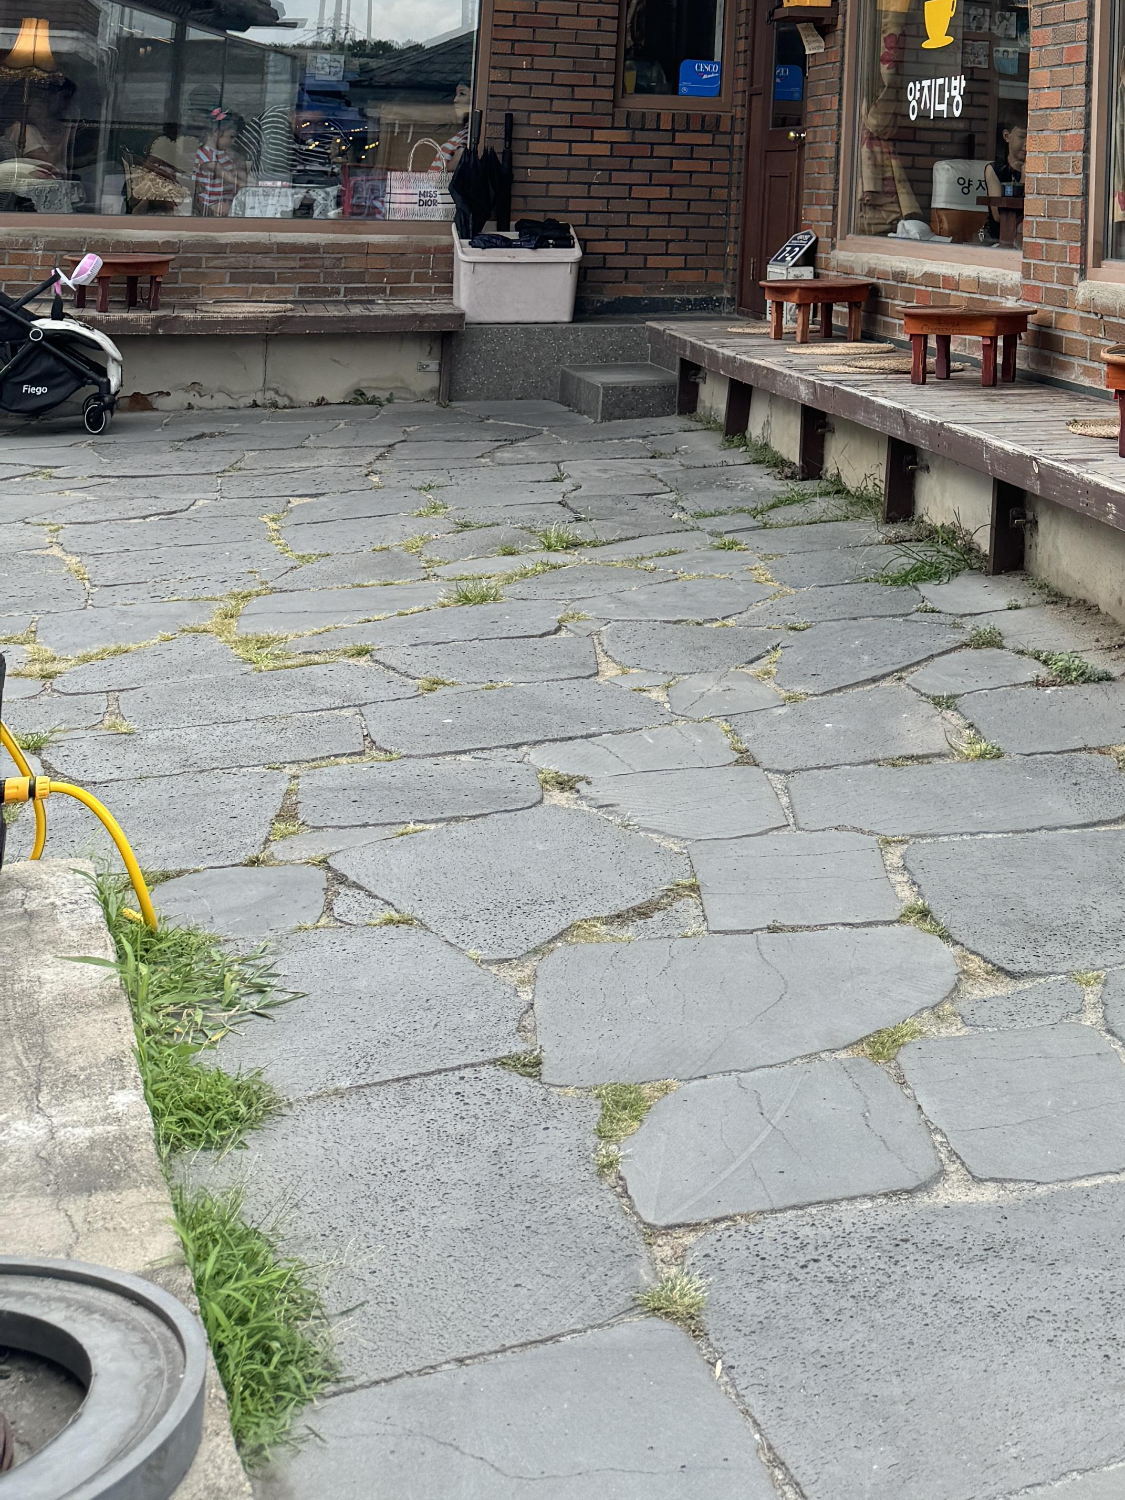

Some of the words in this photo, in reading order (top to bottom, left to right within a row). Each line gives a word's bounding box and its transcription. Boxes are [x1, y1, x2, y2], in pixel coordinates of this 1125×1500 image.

[907, 74, 966, 121] 양지다방
[418, 190, 438, 199] MISS
[418, 199, 438, 207] DIOR
[22, 384, 48, 396] Fiego
